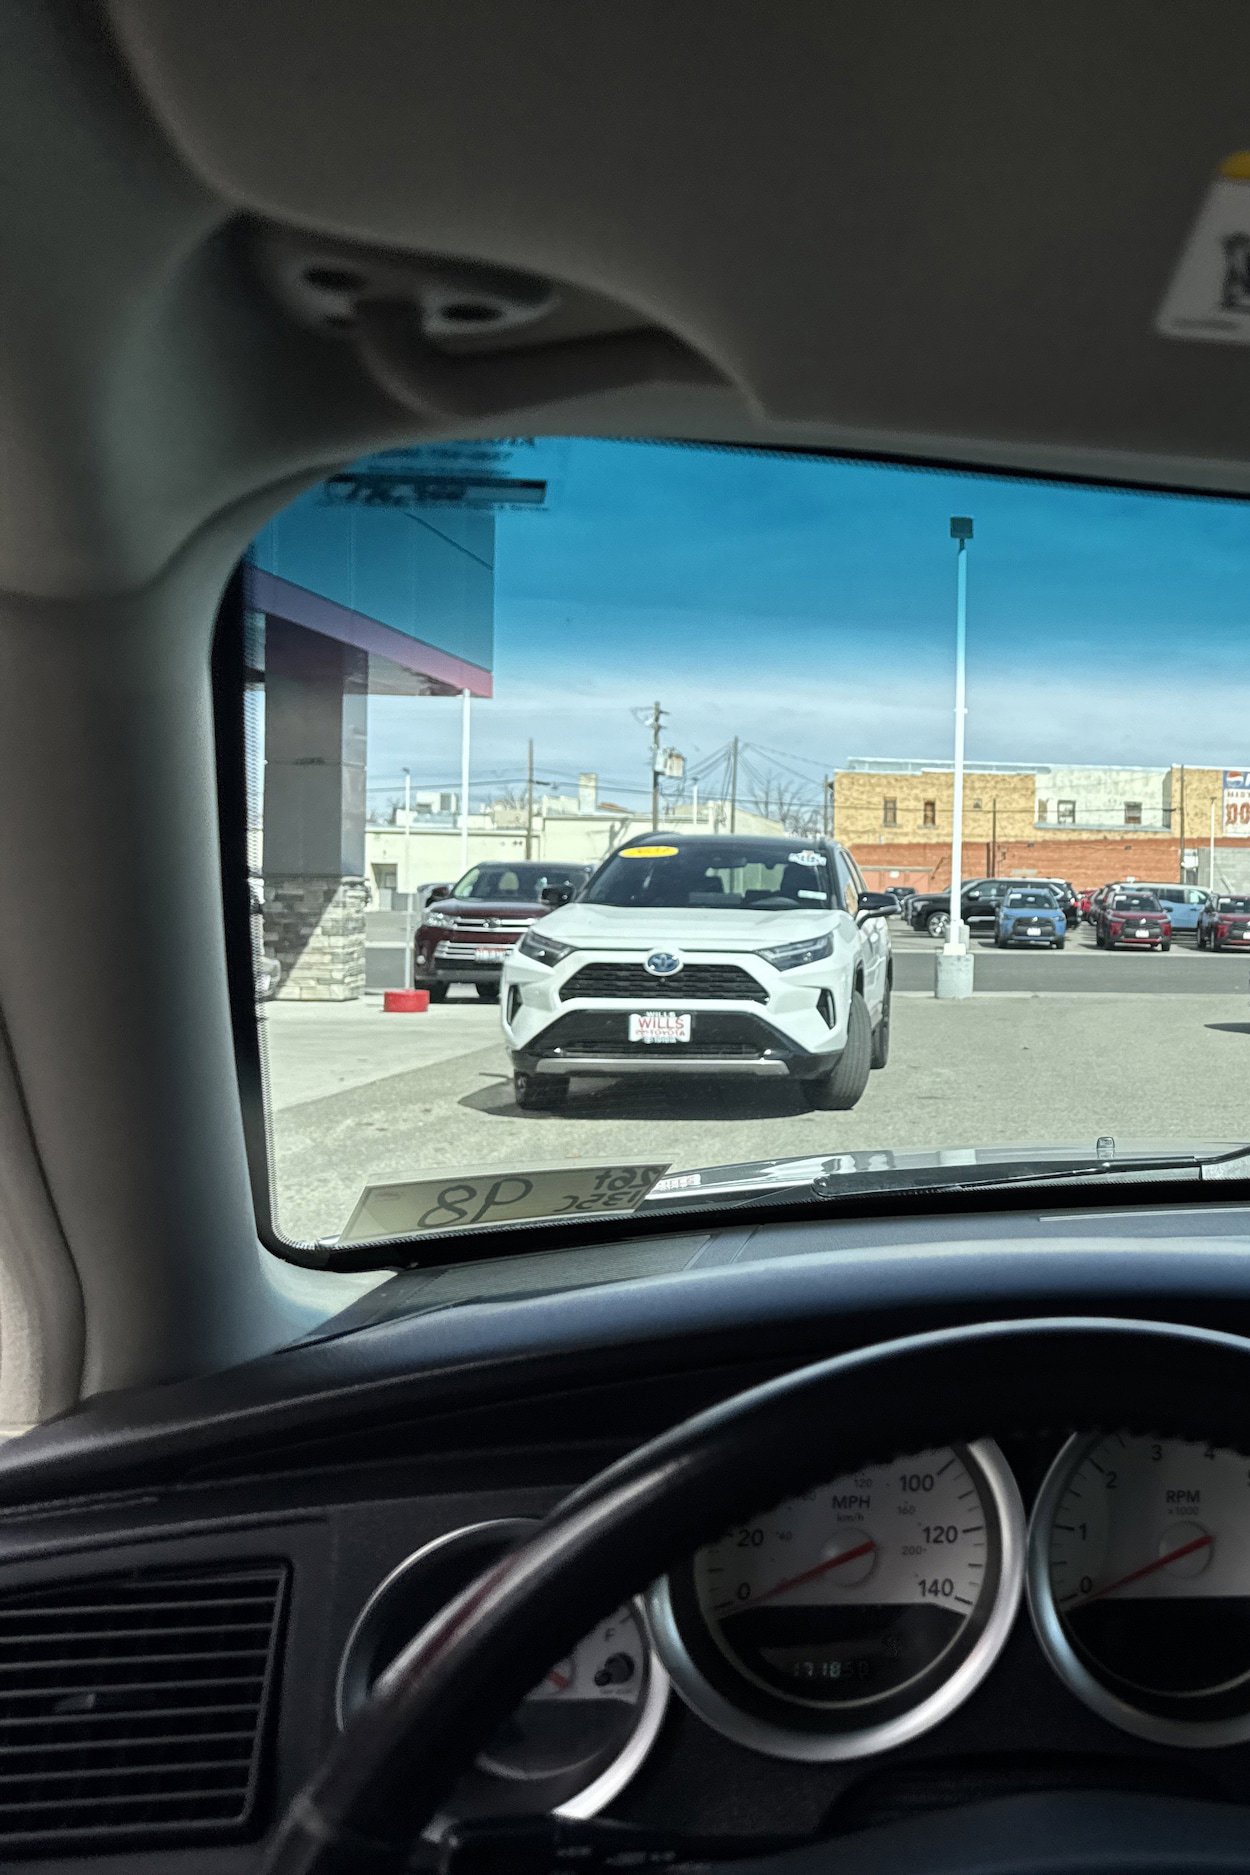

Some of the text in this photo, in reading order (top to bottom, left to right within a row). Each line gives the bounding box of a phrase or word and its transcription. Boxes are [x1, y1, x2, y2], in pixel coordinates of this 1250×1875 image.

[638, 1017, 685, 1030] WILLS
[650, 1029, 686, 1037] TOYOTA
[1151, 1445, 1162, 1461] 3
[900, 1474, 935, 1492] 100
[1105, 1471, 1118, 1488] 2
[831, 1495, 871, 1509] MPH
[1165, 1489, 1201, 1504] RPM
[737, 1529, 764, 1547] 20
[923, 1525, 958, 1544] 120
[1079, 1522, 1087, 1540] 1
[902, 1545, 923, 1555] 200
[737, 1582, 751, 1600] 0
[918, 1578, 954, 1598] 140
[1080, 1575, 1093, 1593] 0
[604, 1627, 616, 1642] F
